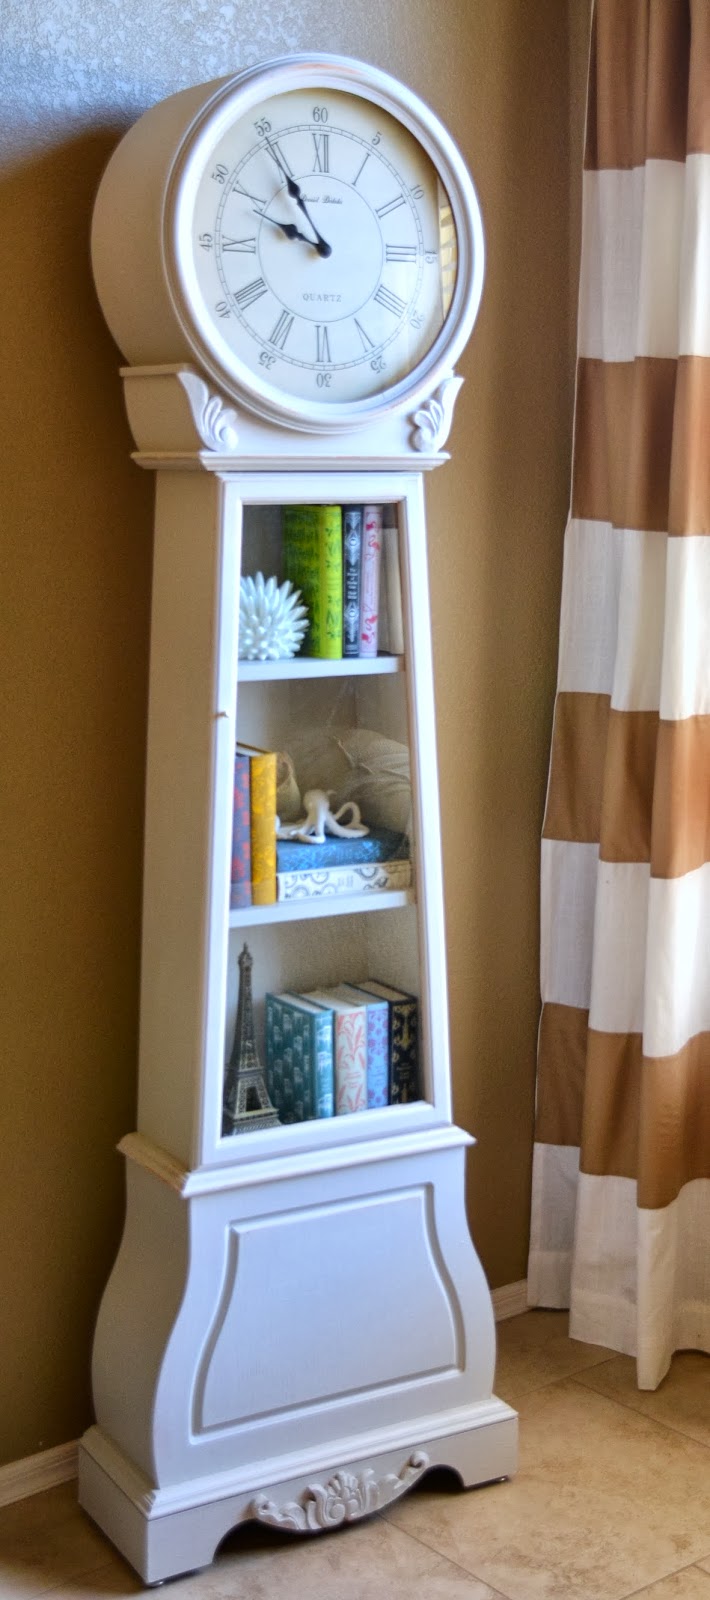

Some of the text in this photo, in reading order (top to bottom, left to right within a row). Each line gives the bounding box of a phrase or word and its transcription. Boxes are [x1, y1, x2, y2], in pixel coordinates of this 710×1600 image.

[312, 106, 329, 123] 60
[254, 117, 272, 137] 55
[371, 131, 382, 146] 5
[312, 132, 330, 173] XII
[211, 163, 229, 185] 50
[232, 180, 266, 212] X
[410, 184, 425, 200] 10
[375, 193, 407, 220] II
[198, 233, 213, 252] 45
[222, 234, 257, 255] IX
[385, 243, 417, 264] III
[424, 250, 438, 264] 15
[233, 277, 268, 311] VIII
[302, 293, 342, 303] QUARTZ
[215, 301, 231, 319] 40
[410, 309, 426, 330] 20
[268, 309, 295, 350] VII
[315, 325, 332, 363] VI
[258, 351, 277, 370] 35
[370, 355, 387, 374] 25
[316, 373, 332, 388] 30
